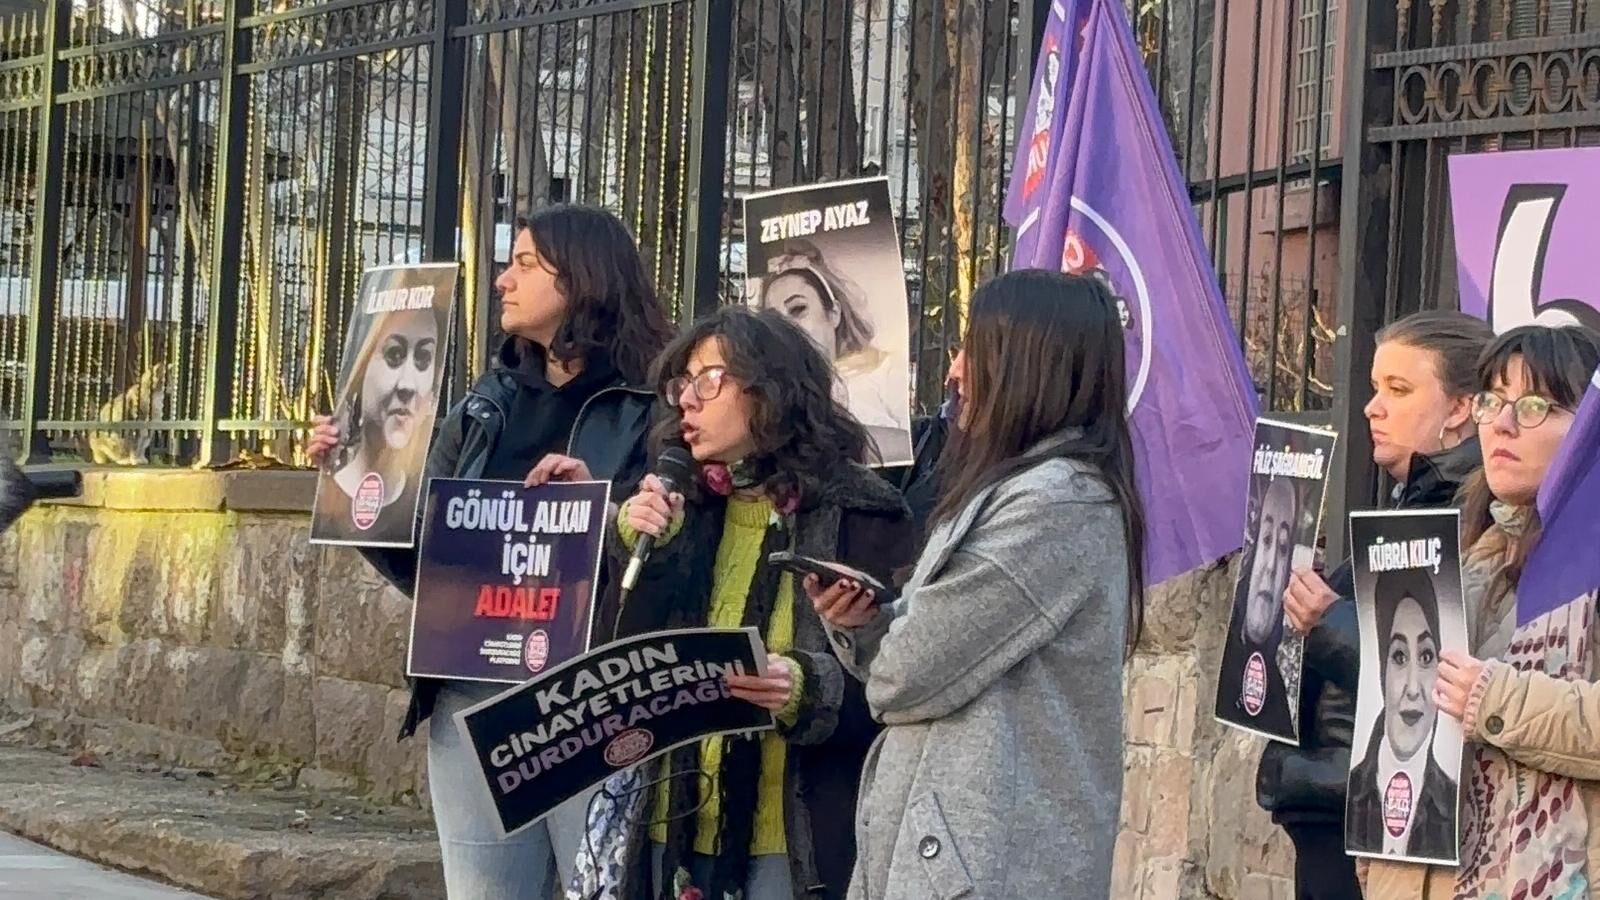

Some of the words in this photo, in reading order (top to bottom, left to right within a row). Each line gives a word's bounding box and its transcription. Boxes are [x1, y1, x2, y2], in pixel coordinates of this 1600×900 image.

[760, 209, 822, 243] ZEYNEP
[824, 200, 870, 232] AYAZ
[446, 488, 529, 532] GÖNÜL
[531, 500, 592, 534] ALKAN
[501, 534, 551, 585] İÇİN
[1368, 536, 1409, 572] KÜBRA
[1409, 537, 1441, 575] KILIÇ
[474, 584, 560, 620] ADALET
[535, 643, 679, 715] KADIN
[489, 659, 748, 768] CİNAYETLERİNİ
